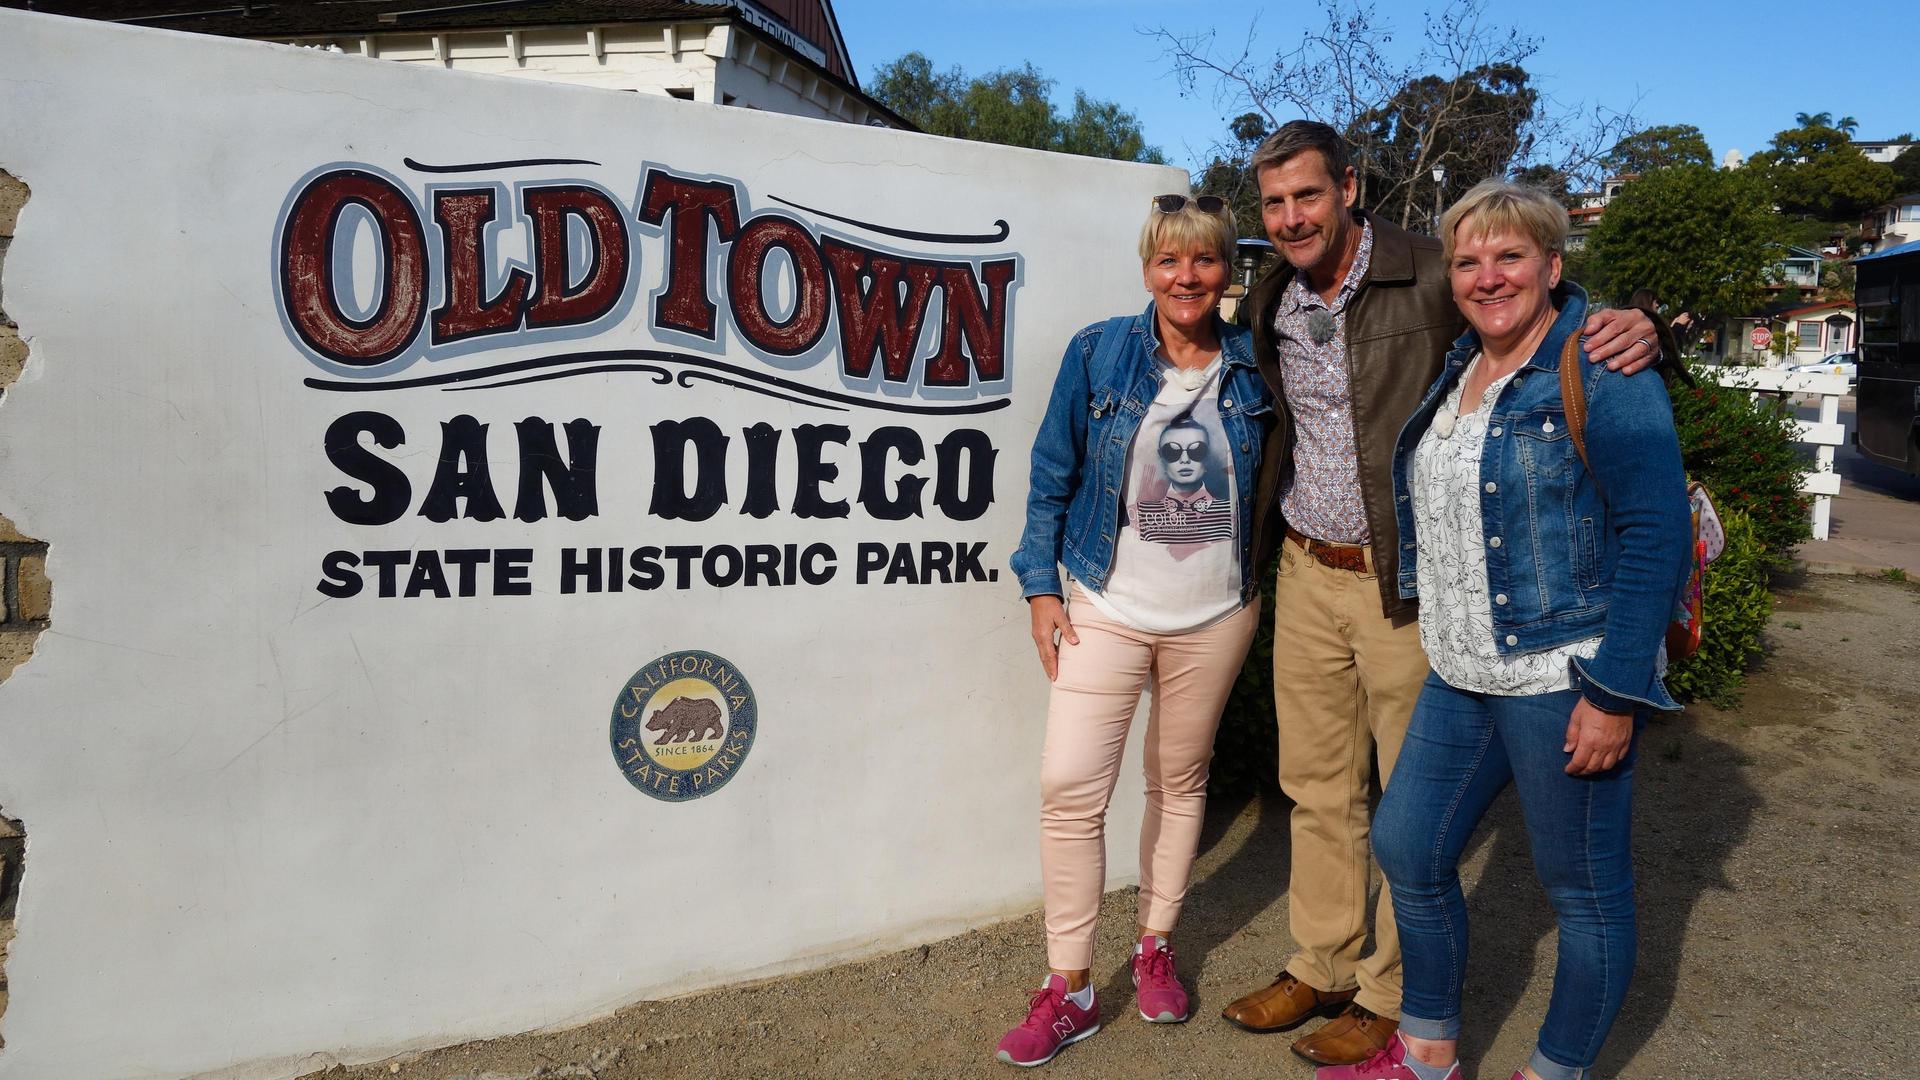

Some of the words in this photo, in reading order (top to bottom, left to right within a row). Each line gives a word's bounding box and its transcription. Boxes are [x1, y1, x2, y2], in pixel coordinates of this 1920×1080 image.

[279, 168, 631, 368] OLD
[637, 166, 1017, 389] TOWN
[1752, 332, 1770, 341] STOP
[323, 410, 602, 526] SAN
[648, 416, 1000, 523] DIEGO
[316, 548, 534, 599] STATE
[560, 543, 838, 595] HISTORIC
[856, 541, 999, 585] PARK.
[621, 656, 748, 719] CALIFORNIA
[619, 738, 680, 793] STATE
[693, 729, 748, 790] PARKS
[655, 747, 688, 758] SINCE
[691, 744, 715, 754] 1864
